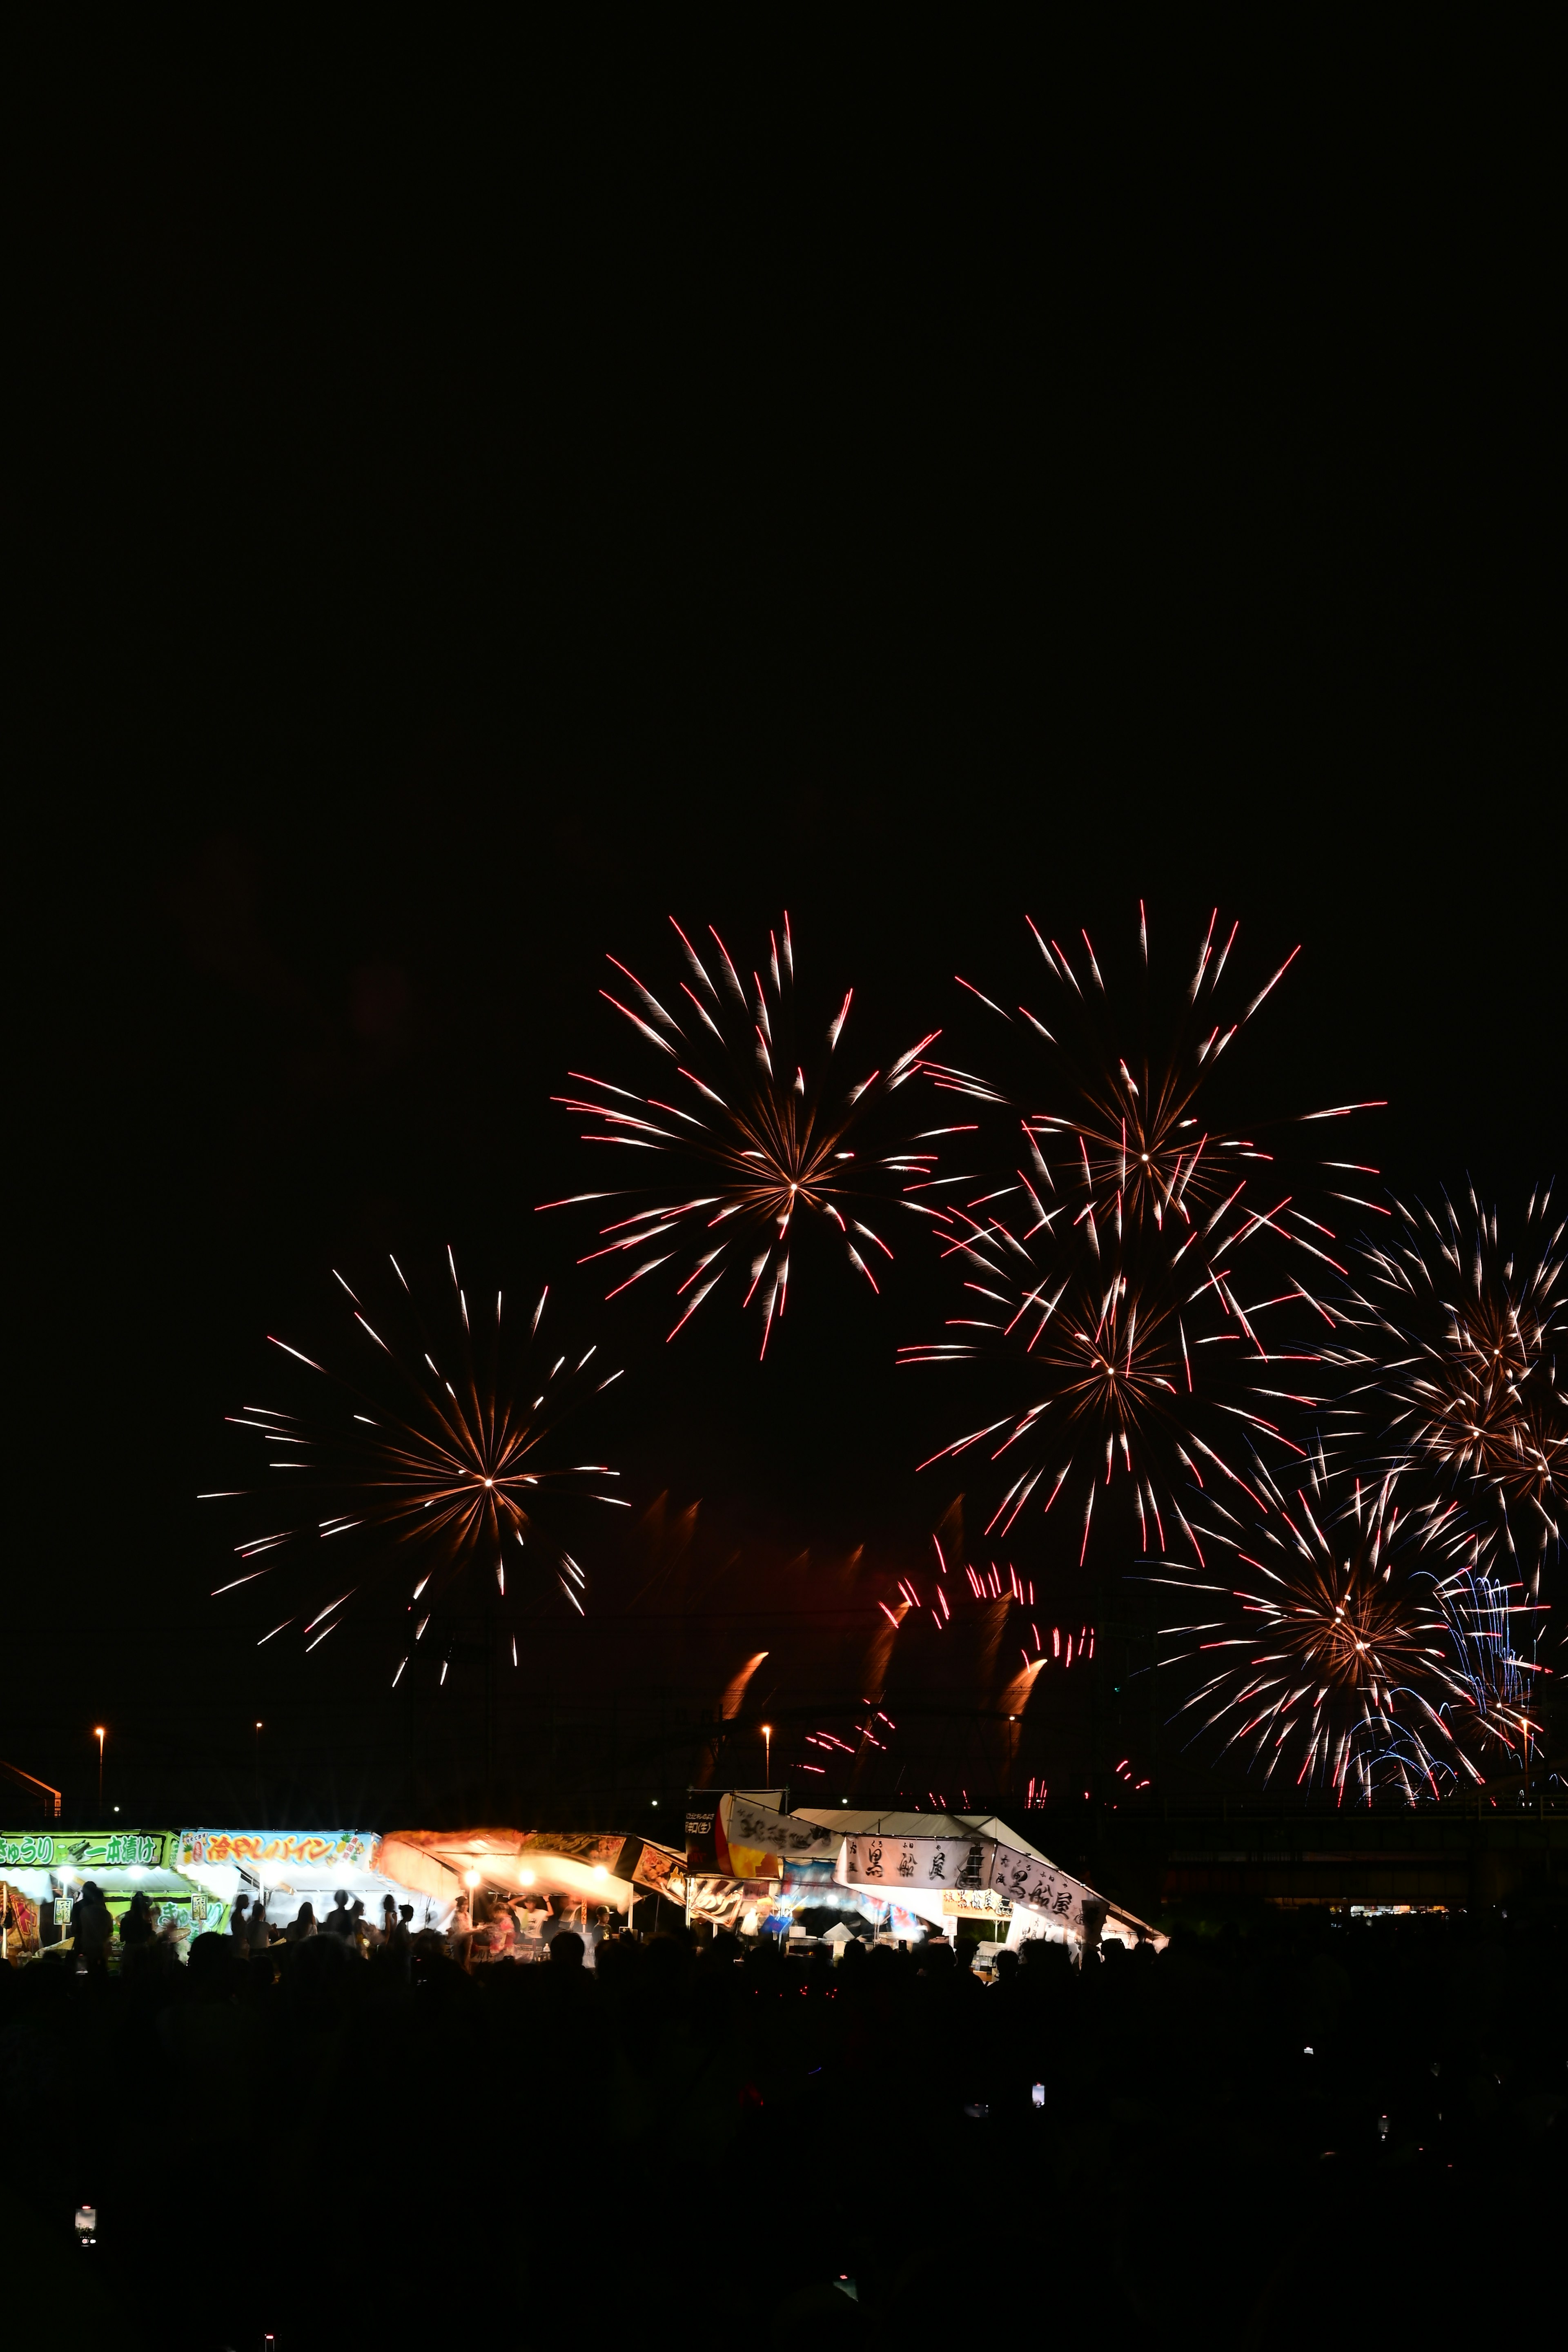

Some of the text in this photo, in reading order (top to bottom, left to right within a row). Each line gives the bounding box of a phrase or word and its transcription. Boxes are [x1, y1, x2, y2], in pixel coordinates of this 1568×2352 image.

[84, 1836, 156, 1863] 一本漬け
[207, 1835, 334, 1861] 冷やしパイン
